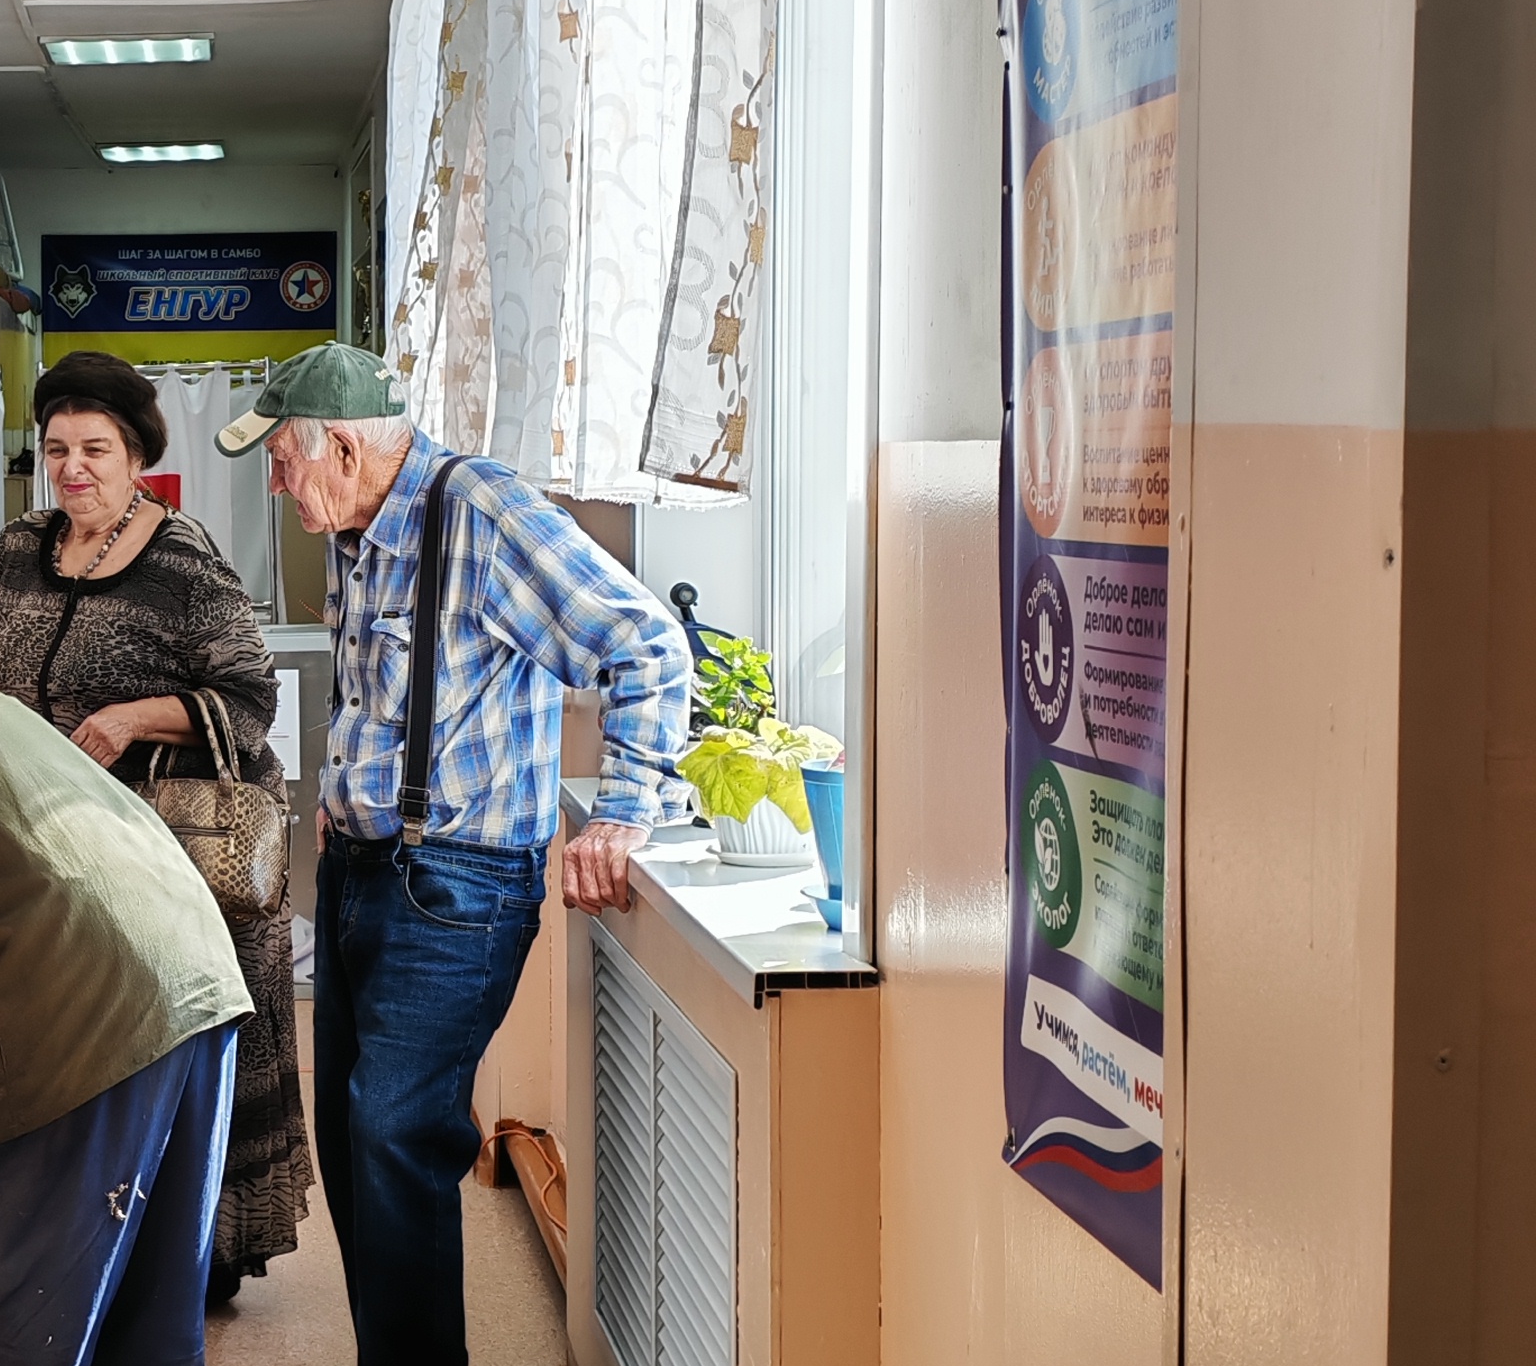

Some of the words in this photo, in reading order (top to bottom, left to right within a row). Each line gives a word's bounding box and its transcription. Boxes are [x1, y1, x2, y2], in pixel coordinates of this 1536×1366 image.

[117, 249, 144, 260] ШАГ
[146, 249, 162, 259] ЗА
[164, 249, 208, 259] ШАГОМ
[210, 249, 219, 259] В
[221, 248, 262, 259] САМБО
[96, 268, 166, 282] ШКОЛЬНЫЙ
[167, 267, 249, 281] СПОРТИВНЫЙ
[249, 268, 280, 281] КЛУБ
[125, 285, 251, 322] ЕНГУР
[1083, 444, 1140, 465] Воспитание
[1083, 478, 1089, 493] к
[1090, 474, 1143, 499] здоровому
[1082, 503, 1127, 528] интереса
[1129, 506, 1136, 526] к
[1083, 574, 1129, 607] Доброе
[1130, 583, 1167, 609] дело
[1083, 610, 1124, 635] делаю
[1126, 615, 1154, 639] сам
[1021, 638, 1072, 725] ДОБРОВОЛЕЦ
[1083, 659, 1164, 695] Формирование
[1084, 693, 1091, 710] и
[1093, 693, 1159, 723] потребности
[1084, 720, 1154, 752] деятельности
[1089, 789, 1144, 833] Защищать
[1091, 820, 1114, 849] Это
[1114, 830, 1145, 870] должен
[1033, 1000, 1080, 1066] Учимся,
[1081, 1039, 1131, 1104] растём,
[1134, 1076, 1163, 1119] меч
